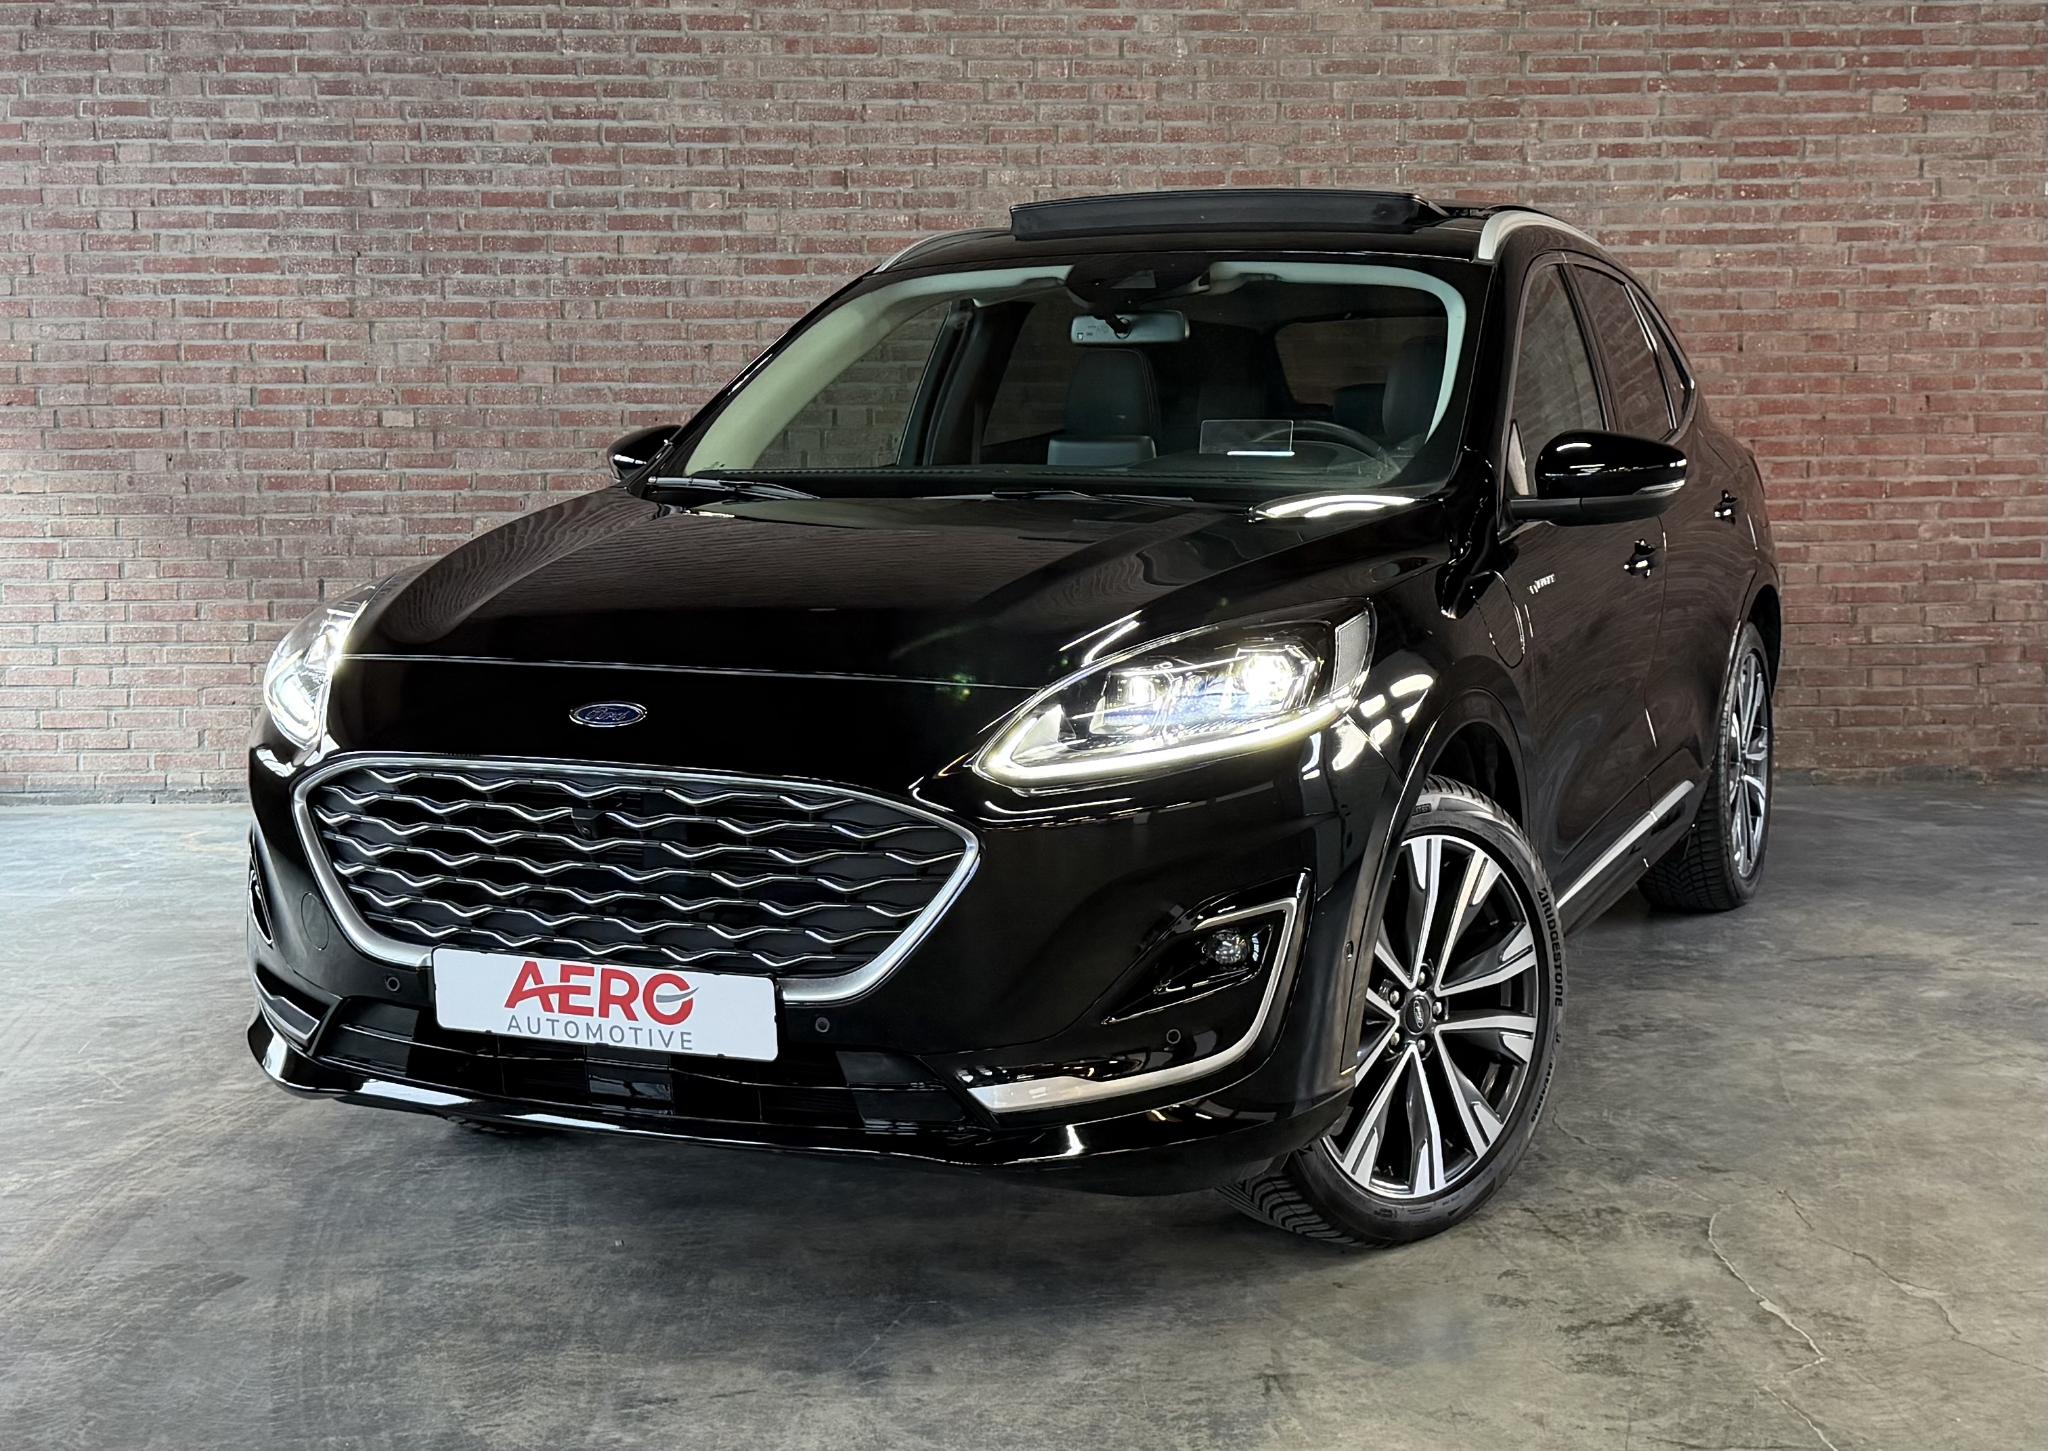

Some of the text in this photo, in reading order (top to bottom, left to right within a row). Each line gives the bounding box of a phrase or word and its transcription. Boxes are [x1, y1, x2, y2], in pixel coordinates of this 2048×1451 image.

[1538, 887, 1564, 1007] BRIDGESTONE
[504, 960, 699, 1025] AERO
[507, 1015, 693, 1050] AUTOMOTIVE
